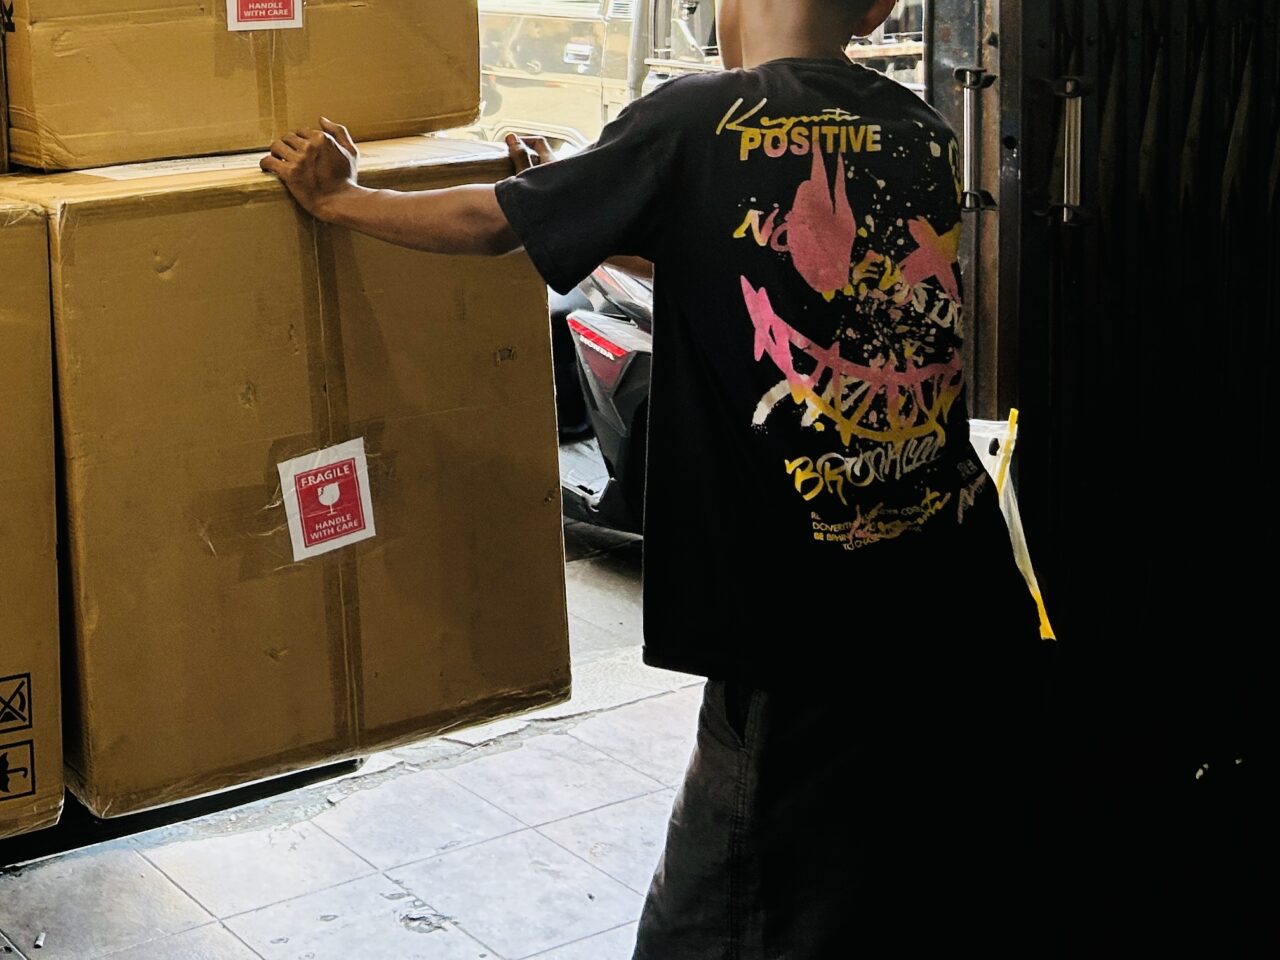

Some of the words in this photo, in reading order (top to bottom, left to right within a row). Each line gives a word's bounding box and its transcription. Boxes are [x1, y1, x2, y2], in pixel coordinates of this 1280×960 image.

[248, 2, 282, 10] HANDLE
[739, 124, 882, 162] POSITIVE
[580, 334, 615, 360] HONDA
[300, 464, 350, 487] FRAGILE
[310, 528, 335, 540] WITH
[336, 521, 359, 532] CARE
[315, 514, 352, 531] HANDLE
